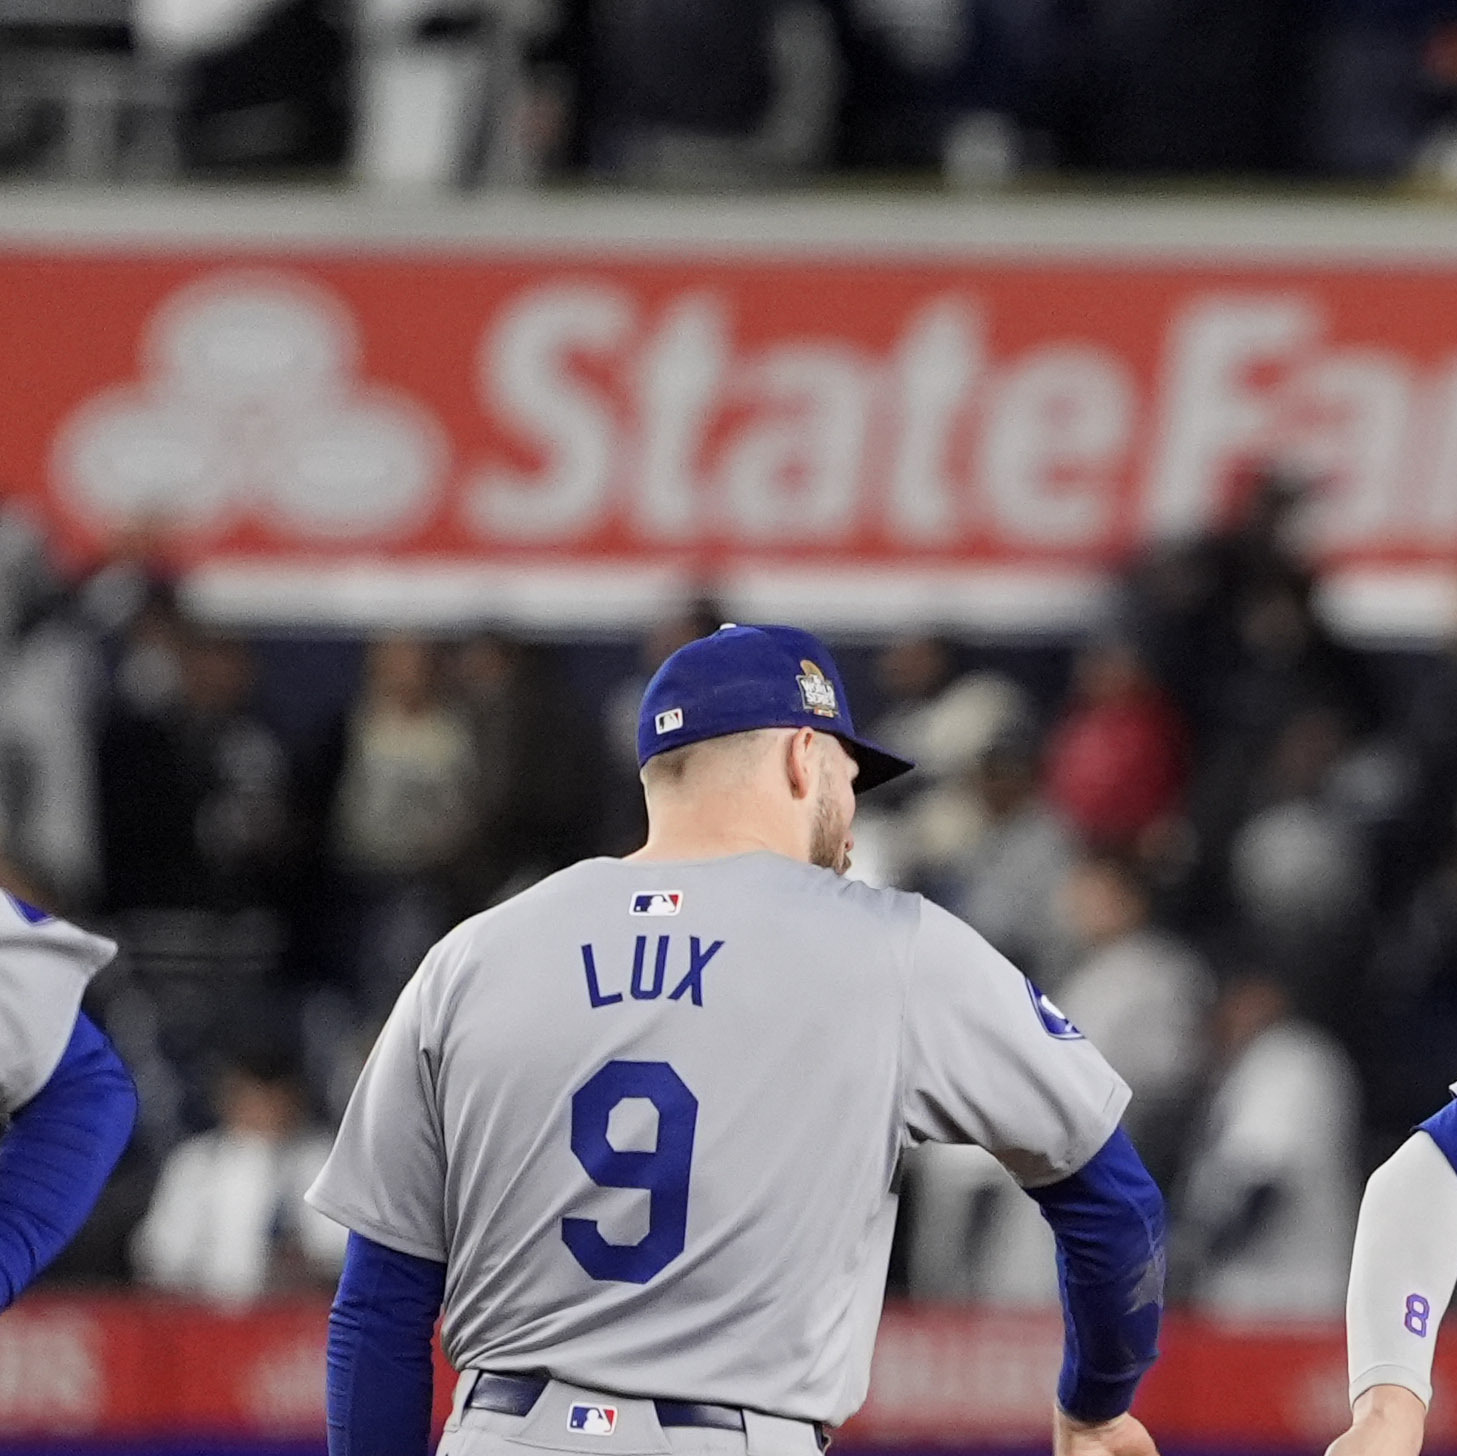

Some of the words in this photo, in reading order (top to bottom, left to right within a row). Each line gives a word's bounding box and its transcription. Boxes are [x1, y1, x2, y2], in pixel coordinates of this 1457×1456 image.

[580, 935, 725, 1009] LUX
[561, 1059, 699, 1285] 9
[1404, 1293, 1430, 1338] 8
